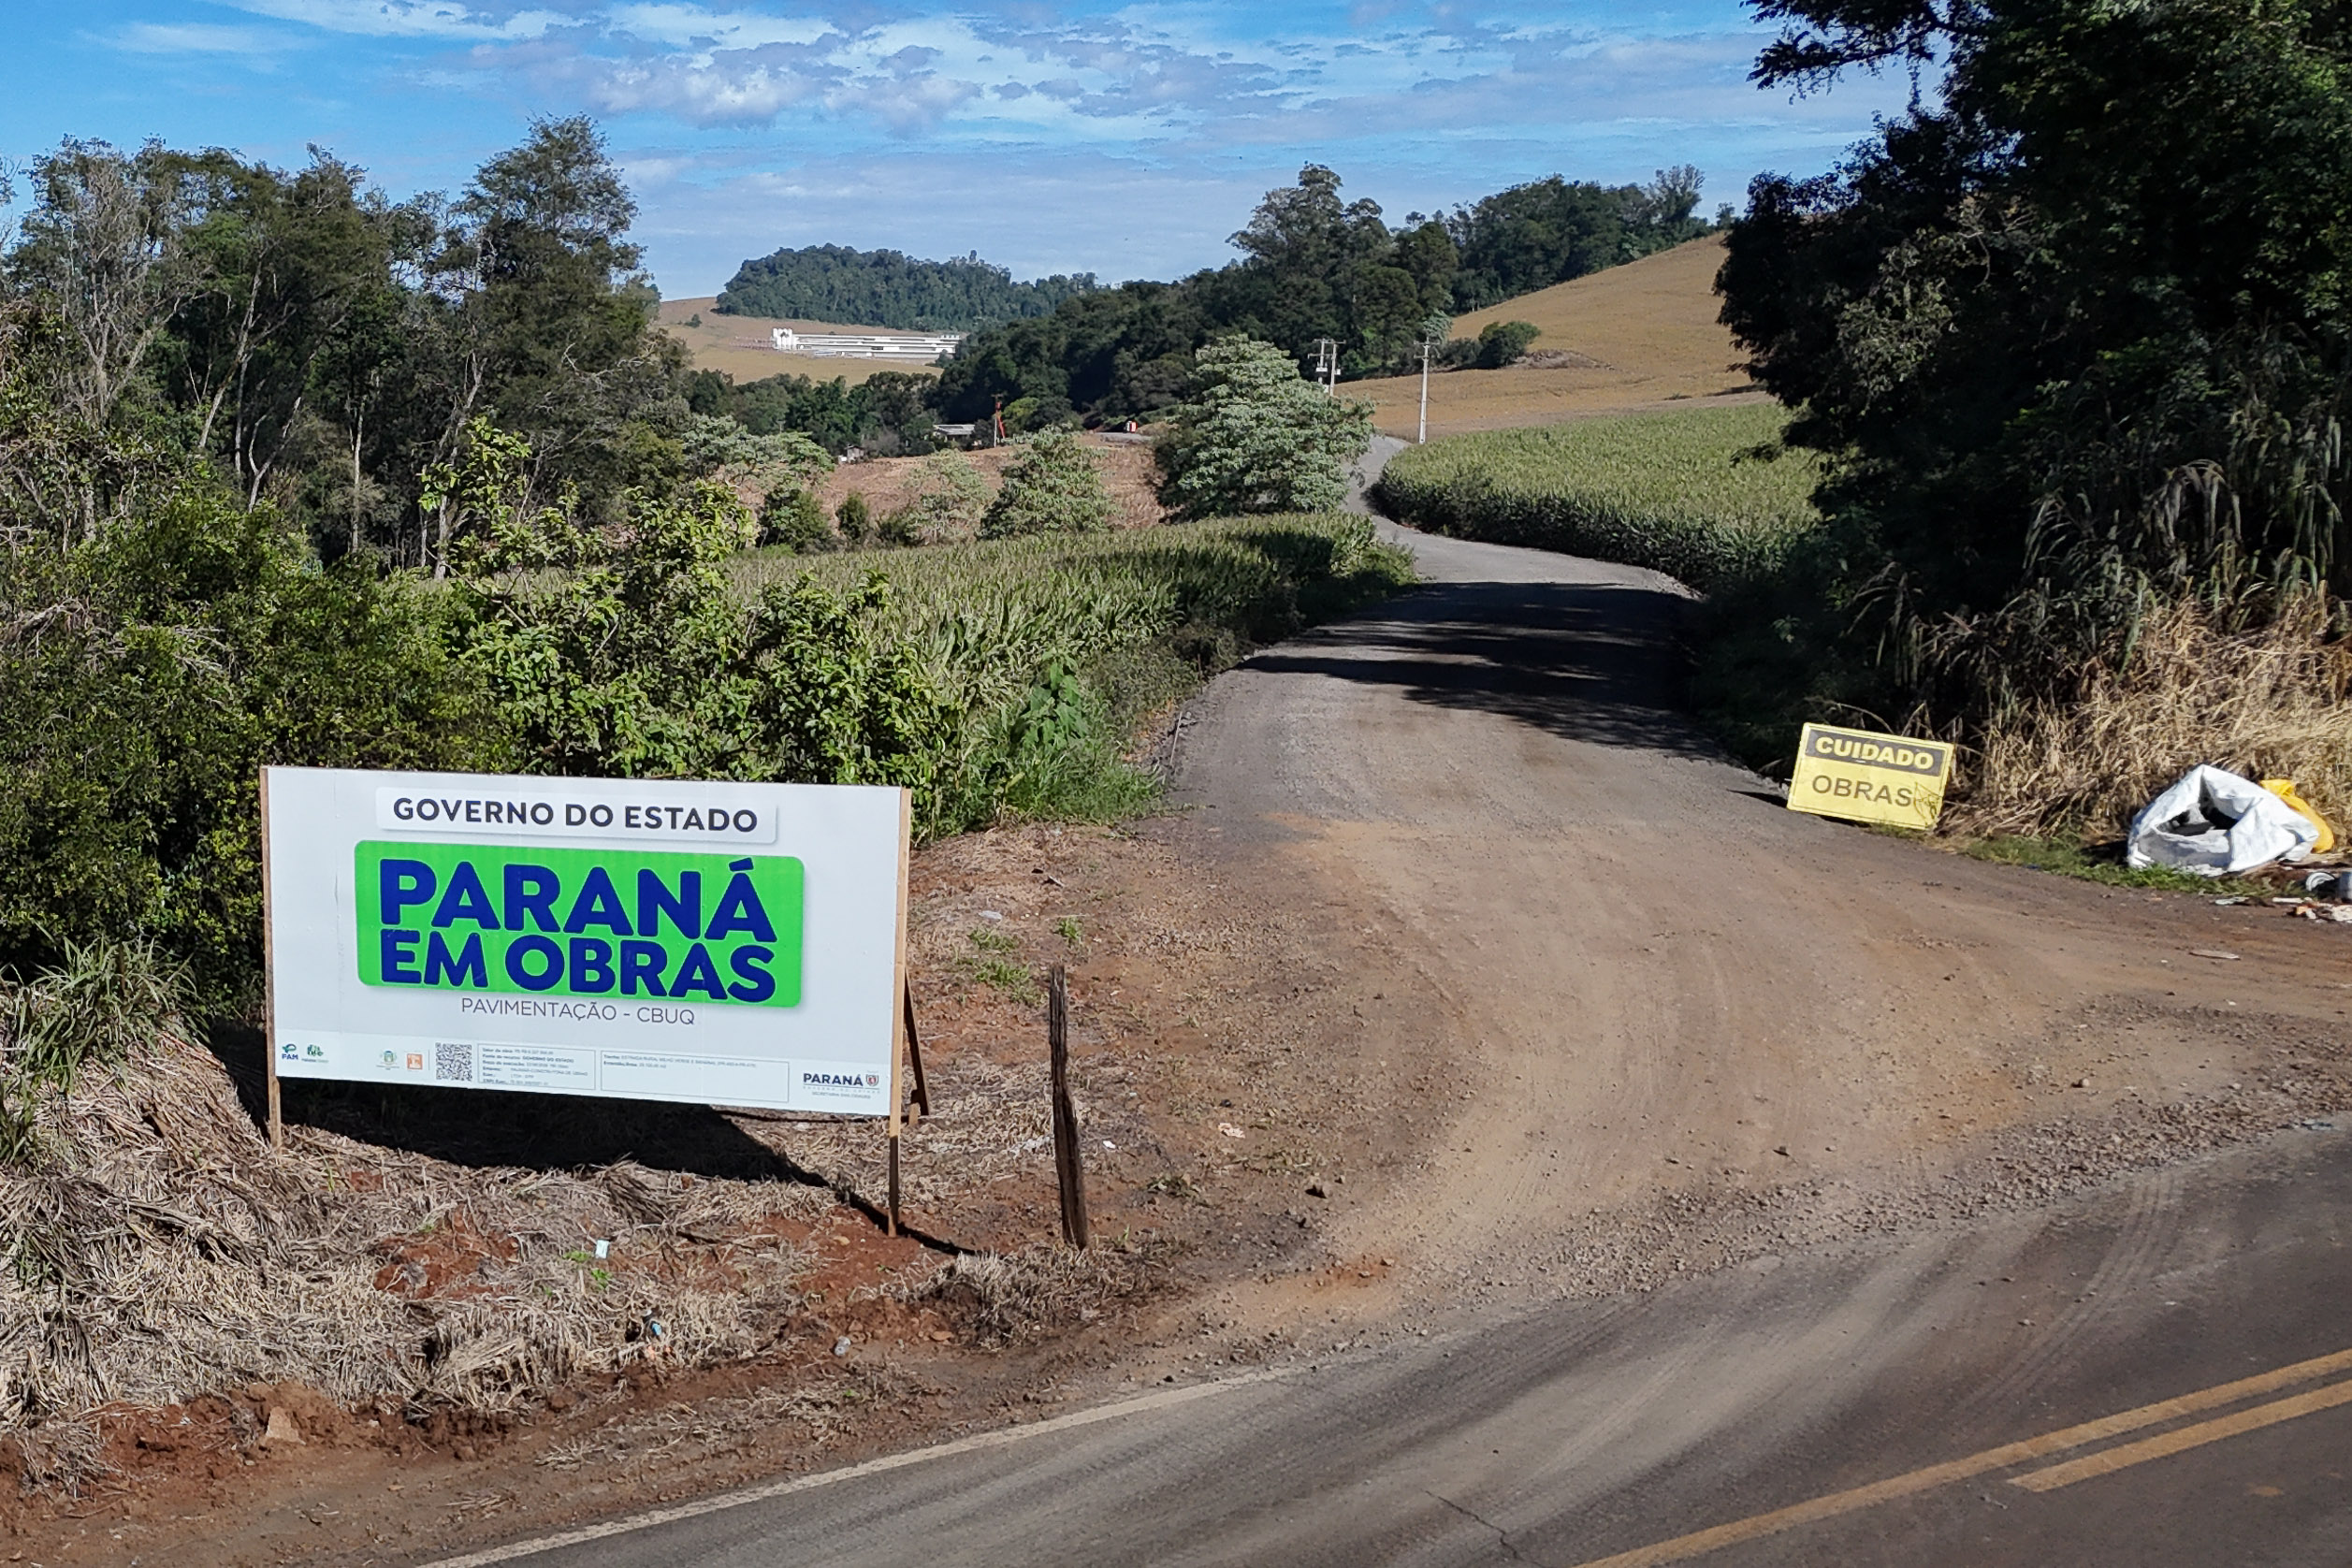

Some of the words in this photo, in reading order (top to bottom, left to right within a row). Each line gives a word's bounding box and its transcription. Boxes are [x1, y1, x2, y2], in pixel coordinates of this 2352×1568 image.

[1815, 736, 1934, 769] CUIDADO
[1811, 775, 1914, 807] OBRAS
[393, 797, 554, 825] GOVERNO
[565, 804, 614, 827] DO
[625, 806, 758, 833] ESTADO
[380, 858, 777, 943] PARANÁ
[380, 928, 489, 988] EM
[505, 935, 777, 1003] OBRAS
[461, 997, 617, 1021] PAVIMENTAÇÃO
[636, 1007, 695, 1025] CBUQ
[803, 1073, 864, 1086] PARANÁ
